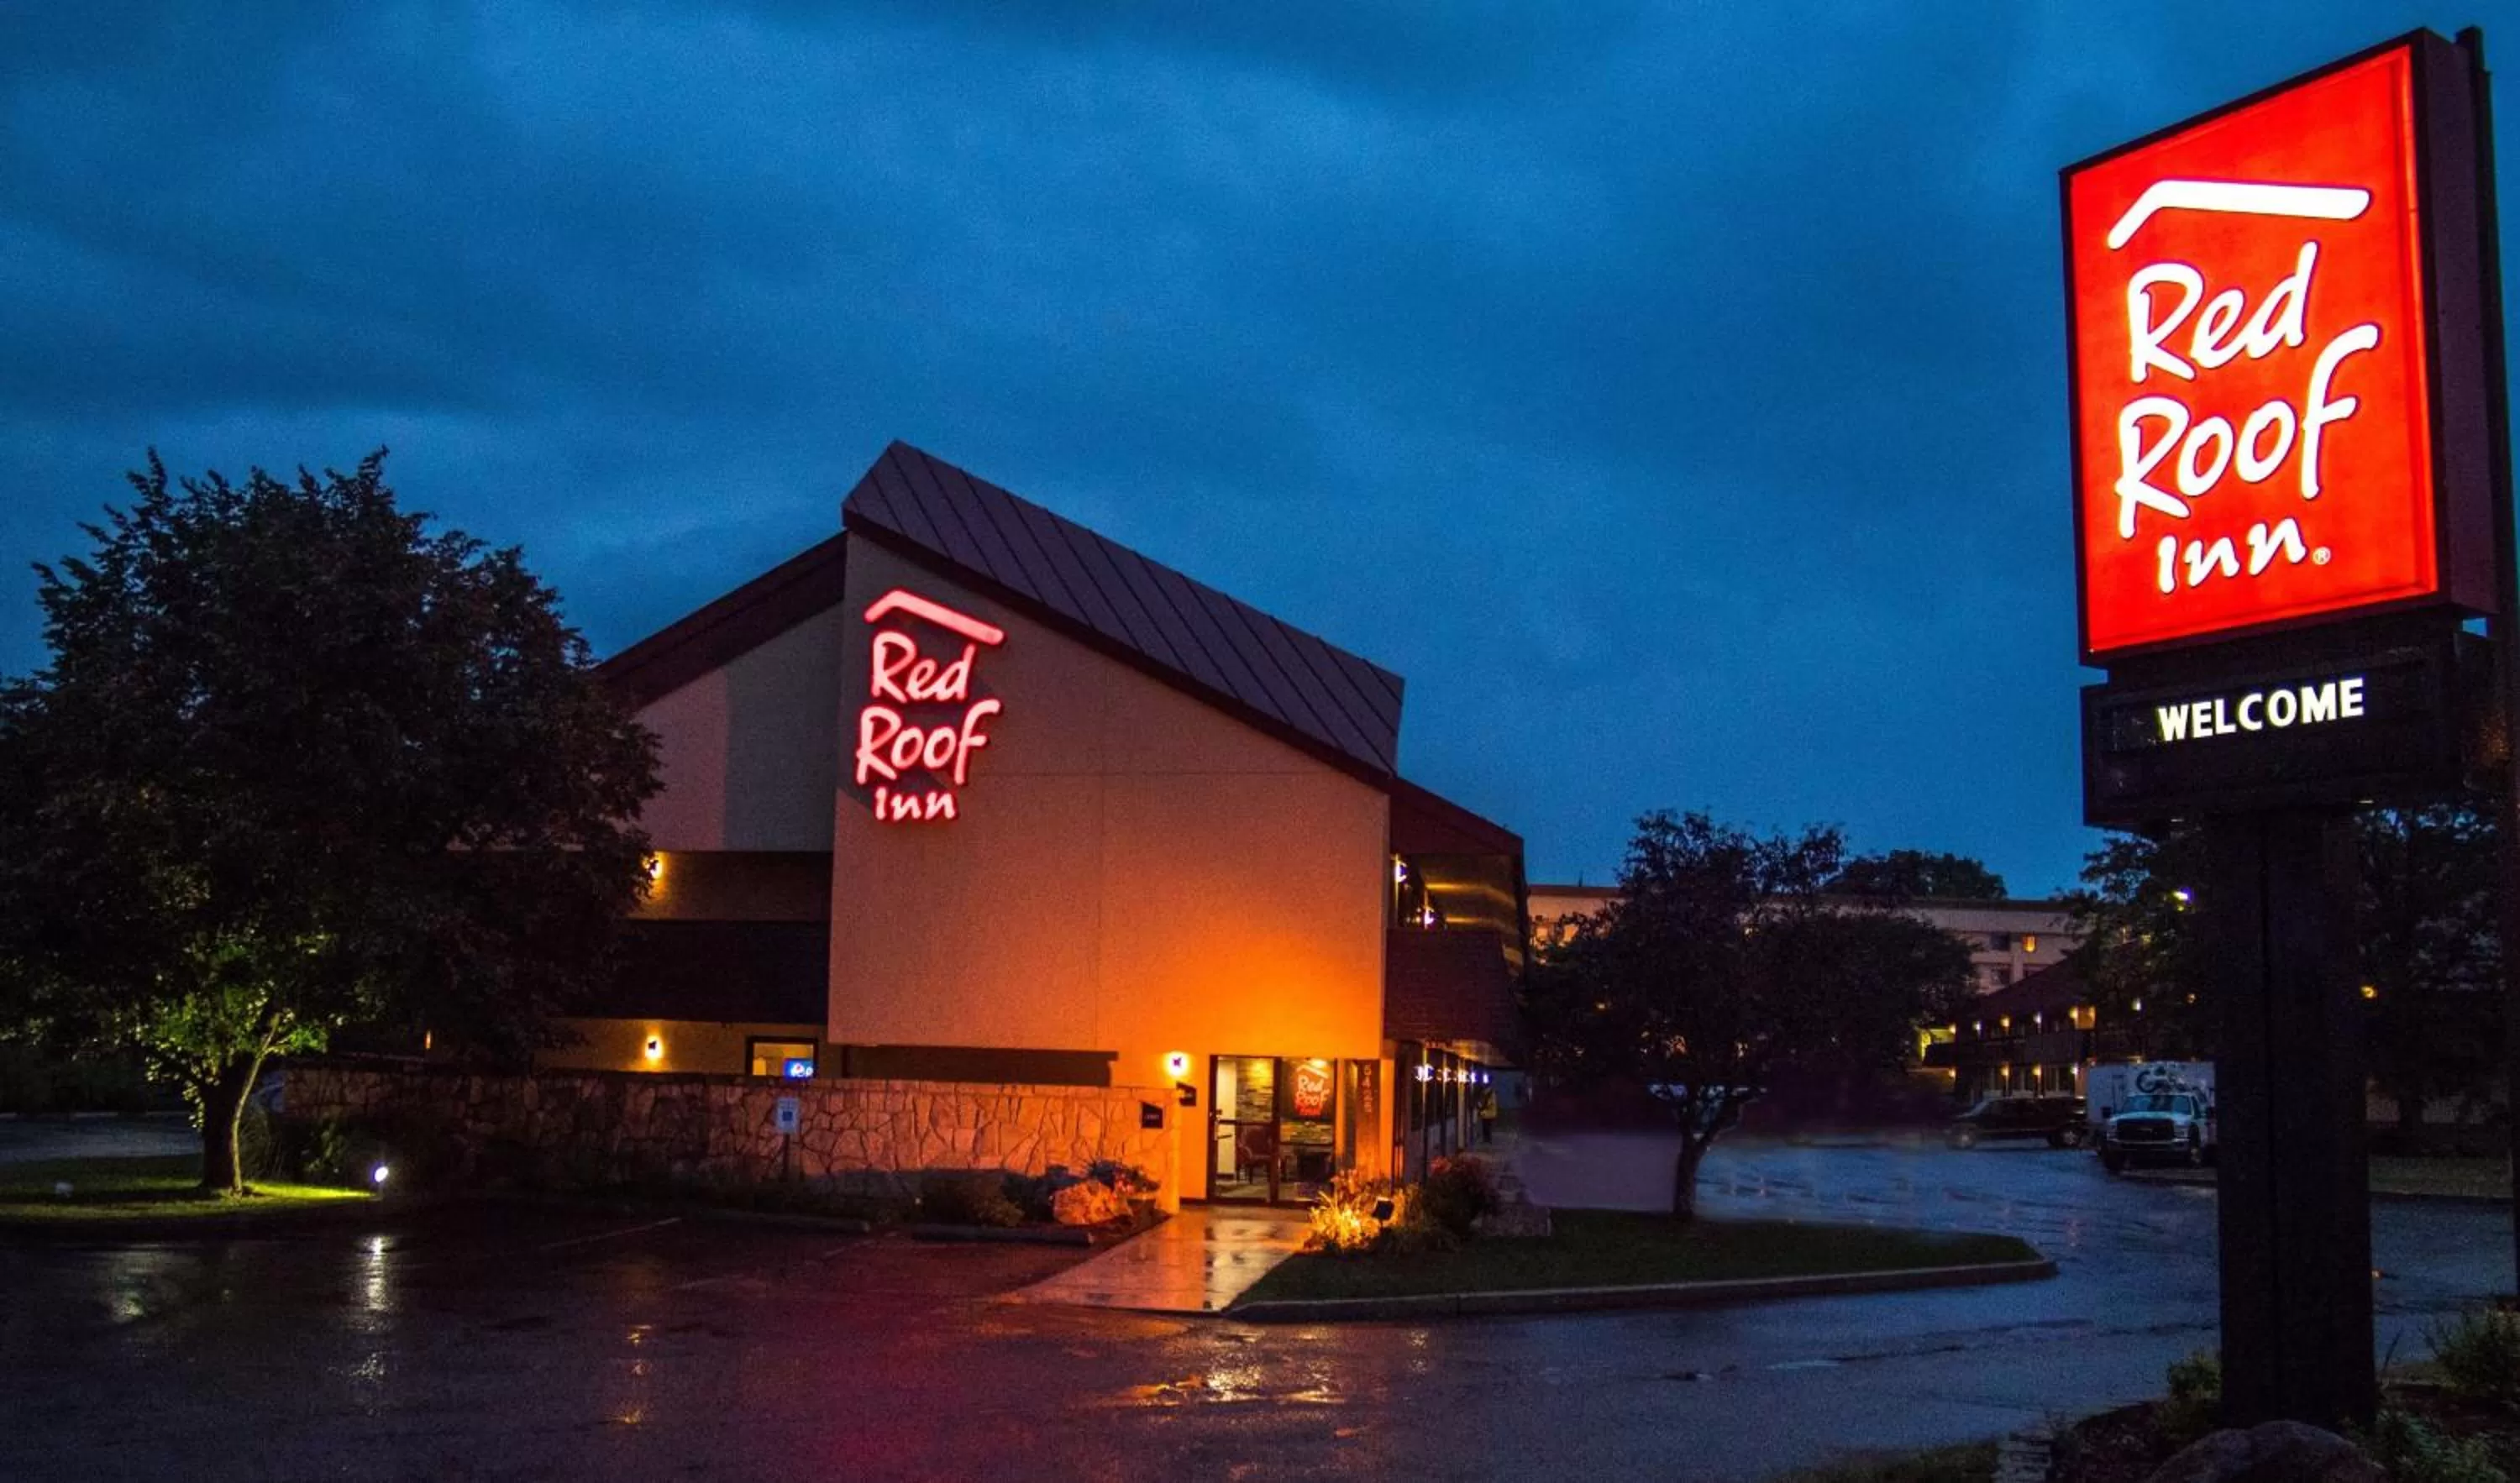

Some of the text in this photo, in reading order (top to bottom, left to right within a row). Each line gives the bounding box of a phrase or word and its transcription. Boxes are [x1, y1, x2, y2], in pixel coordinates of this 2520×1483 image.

[2125, 241, 2318, 384] Red
[2113, 324, 2378, 539] Roof
[870, 631, 976, 703] Red
[855, 699, 1002, 785] Roof
[2157, 678, 2365, 743] WELCOME
[874, 786, 958, 820] Inn
